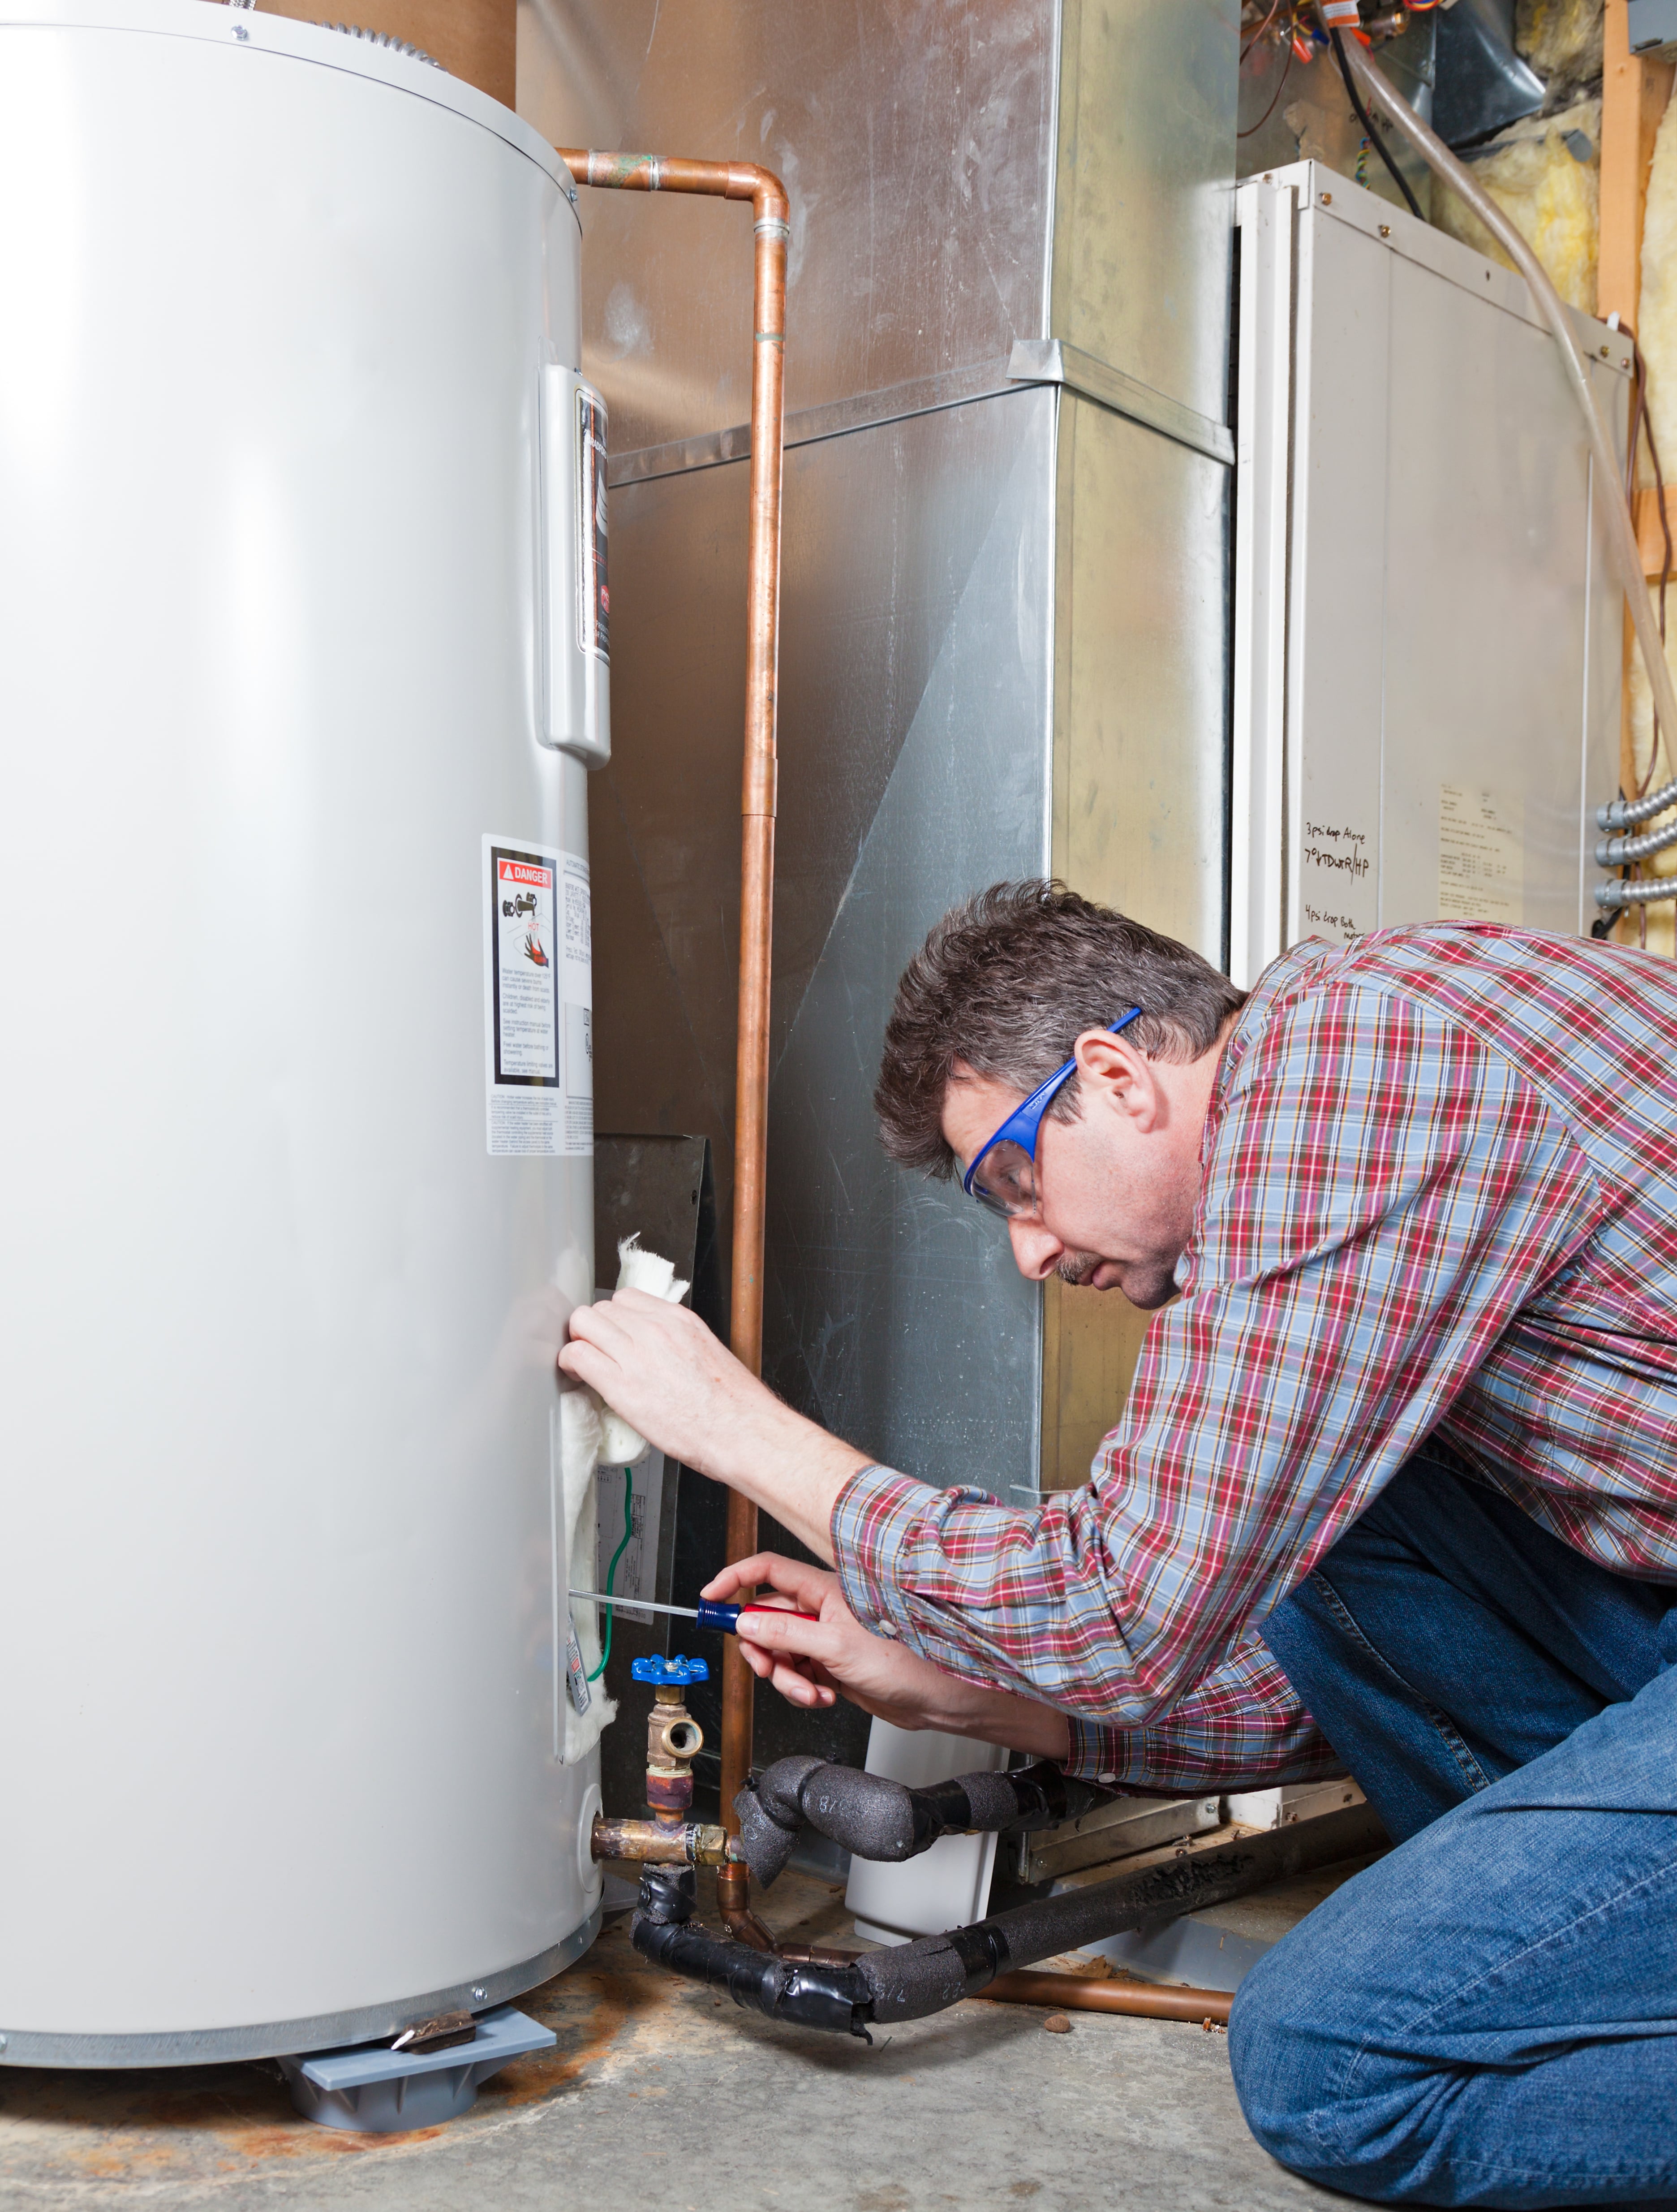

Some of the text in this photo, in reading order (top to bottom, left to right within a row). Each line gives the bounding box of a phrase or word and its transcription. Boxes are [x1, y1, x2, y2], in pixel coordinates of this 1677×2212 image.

[1343, 827, 1365, 844] Alone
[515, 867, 547, 884] DANGER
[528, 922, 539, 931] HOT
[1341, 916, 1356, 930] Both
